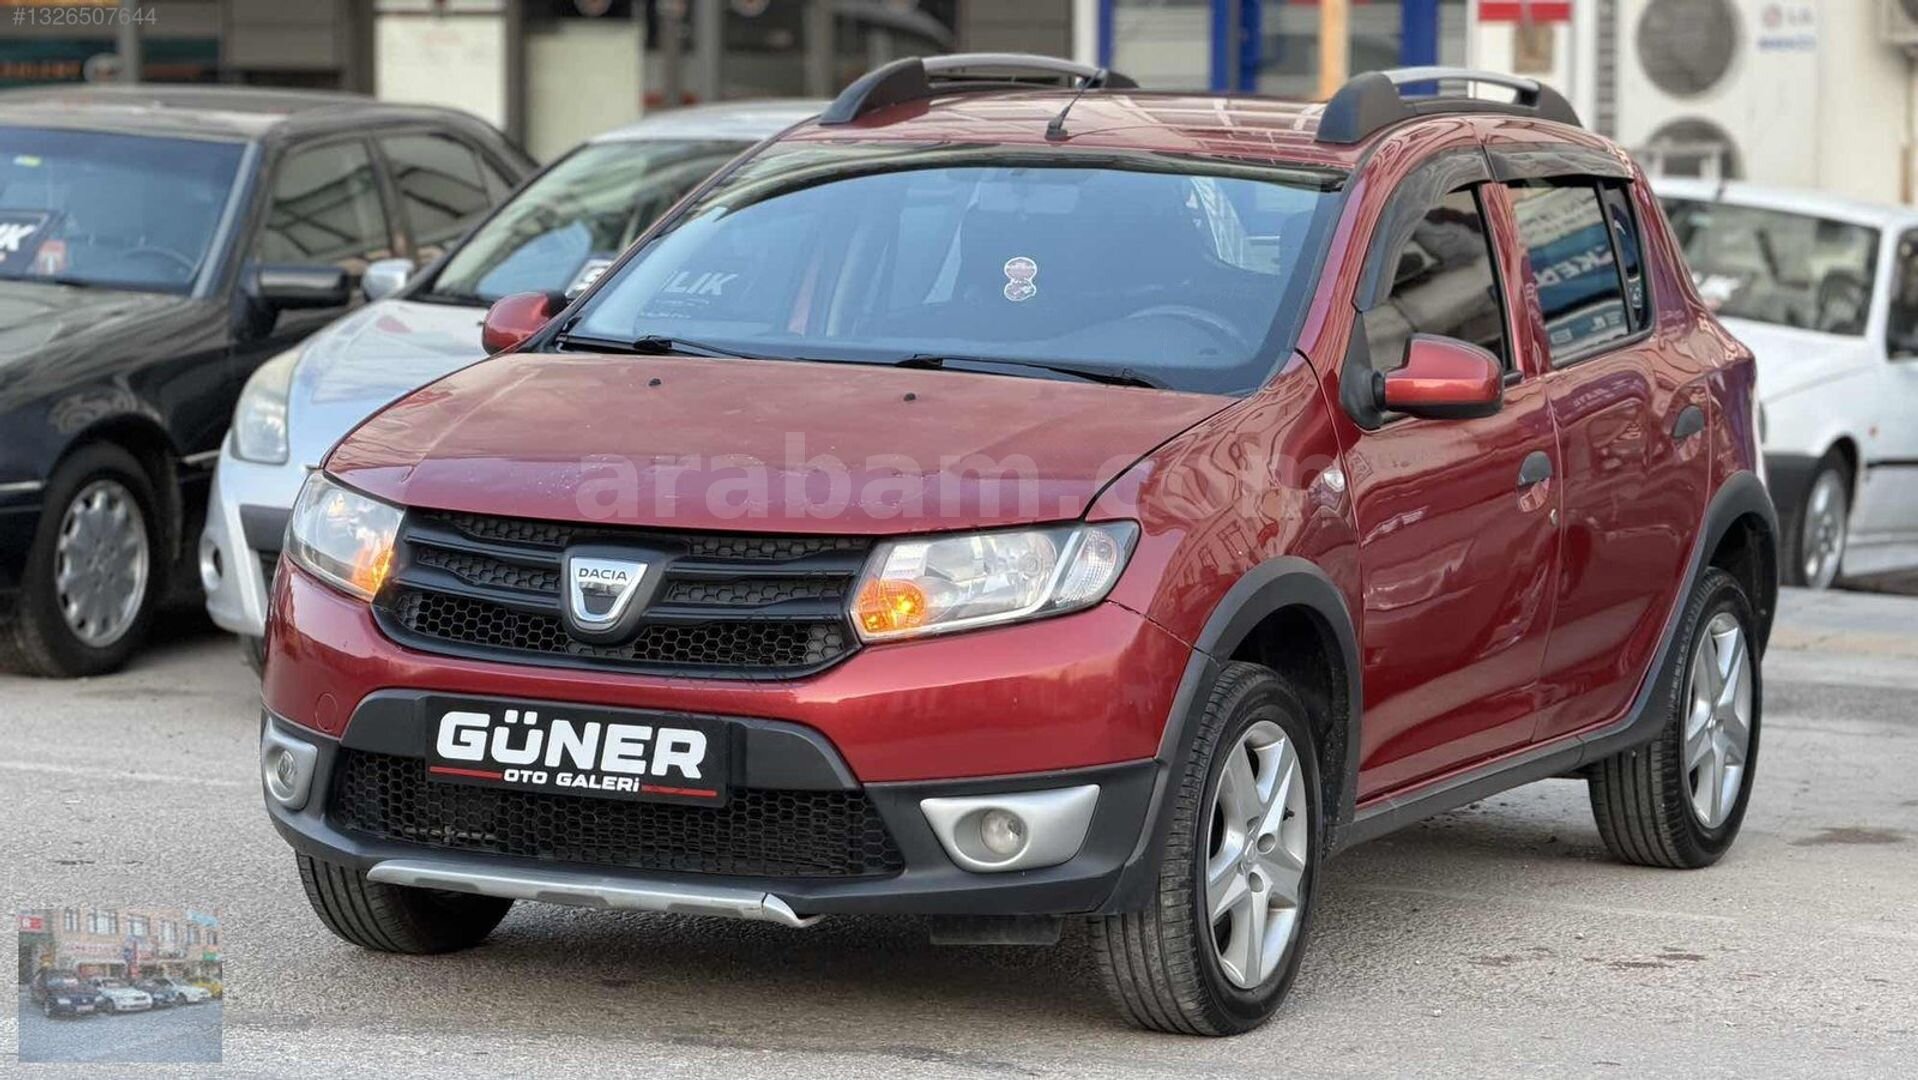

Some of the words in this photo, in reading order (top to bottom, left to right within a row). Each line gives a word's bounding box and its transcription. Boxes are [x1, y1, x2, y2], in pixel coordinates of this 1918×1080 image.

[578, 567, 628, 581] DACIA
[436, 709, 707, 779] GÜNER
[503, 769, 548, 784] OTO
